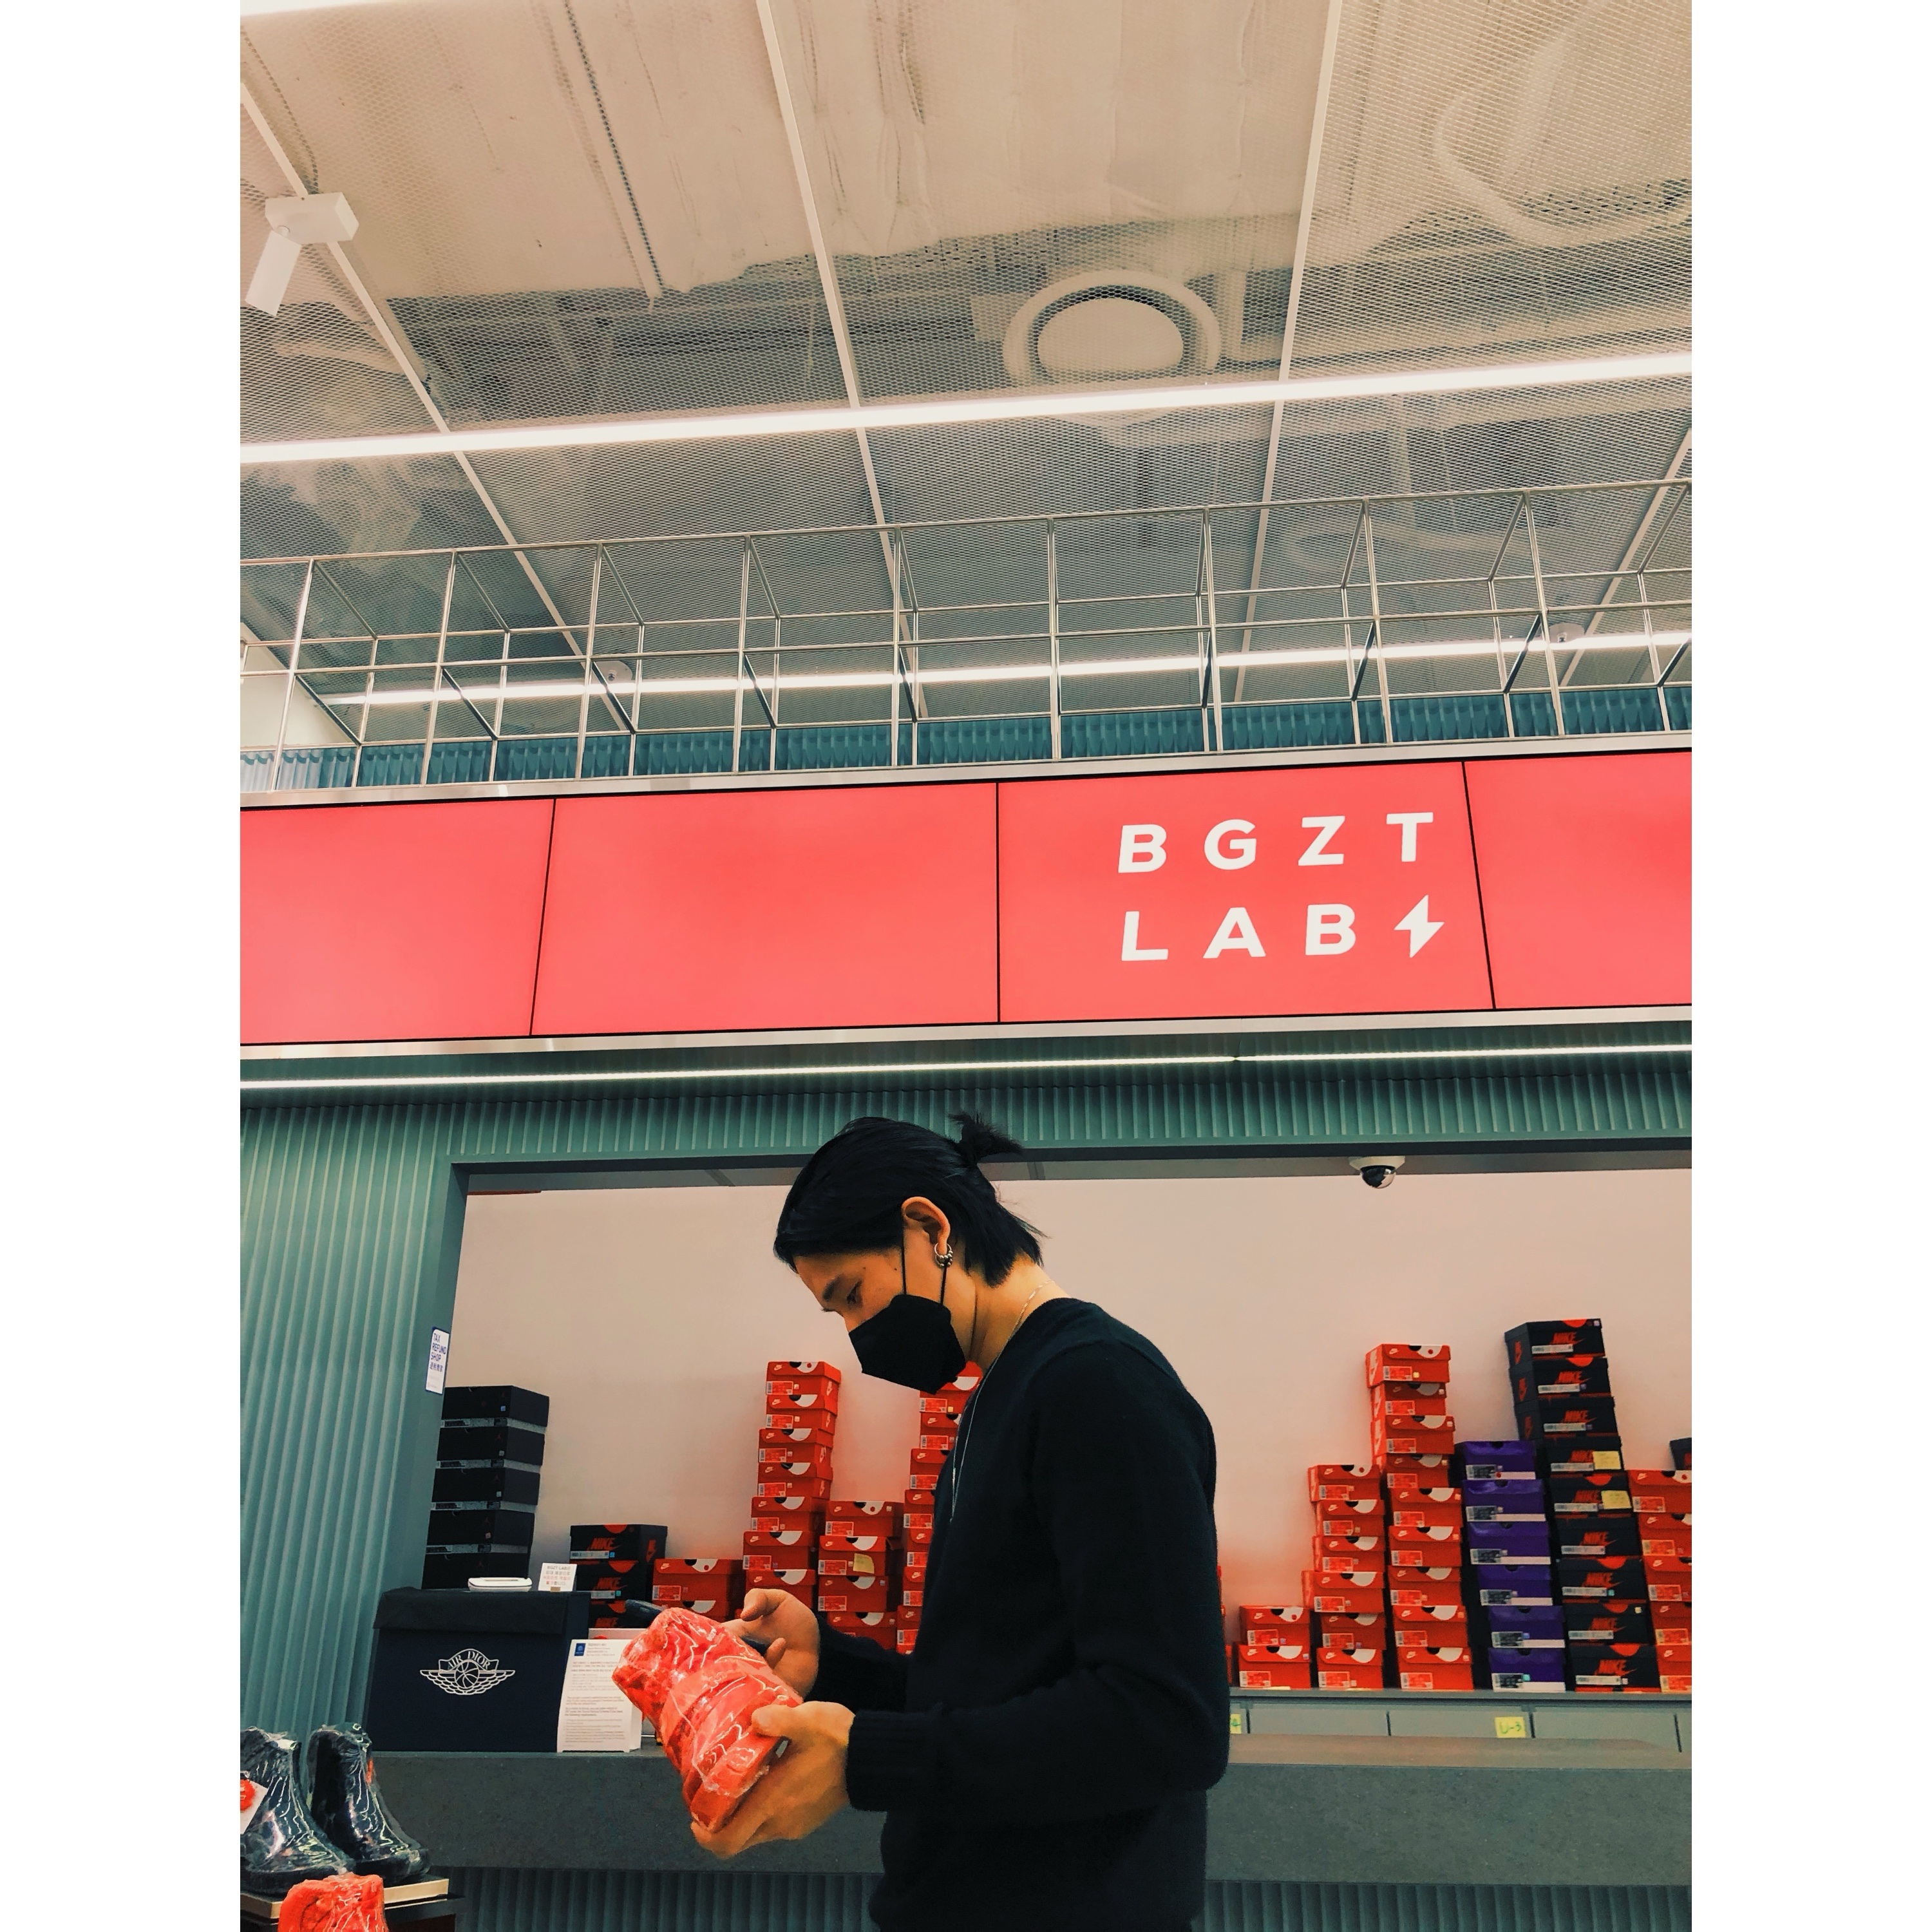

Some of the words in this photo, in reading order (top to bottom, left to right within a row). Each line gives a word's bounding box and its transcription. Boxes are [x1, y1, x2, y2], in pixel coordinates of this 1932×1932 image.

[1118, 811, 1434, 873] BGZT
[1121, 904, 1357, 961] LAB
[1551, 1332, 1577, 1345] NIKE
[432, 1342, 447, 1354] REFUND
[431, 1352, 441, 1362] SHOP
[1555, 1370, 1582, 1383] NIKE
[1561, 1410, 1589, 1423] NIKE
[587, 1537, 615, 1550] NIKE
[1580, 1531, 1609, 1546] NIKE
[592, 1577, 621, 1590] NIKE
[1582, 1572, 1613, 1587] NIKE
[1589, 1617, 1617, 1631] NIKE
[448, 1654, 463, 1670] AIR
[468, 1651, 491, 1670] DIOR
[1594, 1659, 1626, 1675] NIKE
